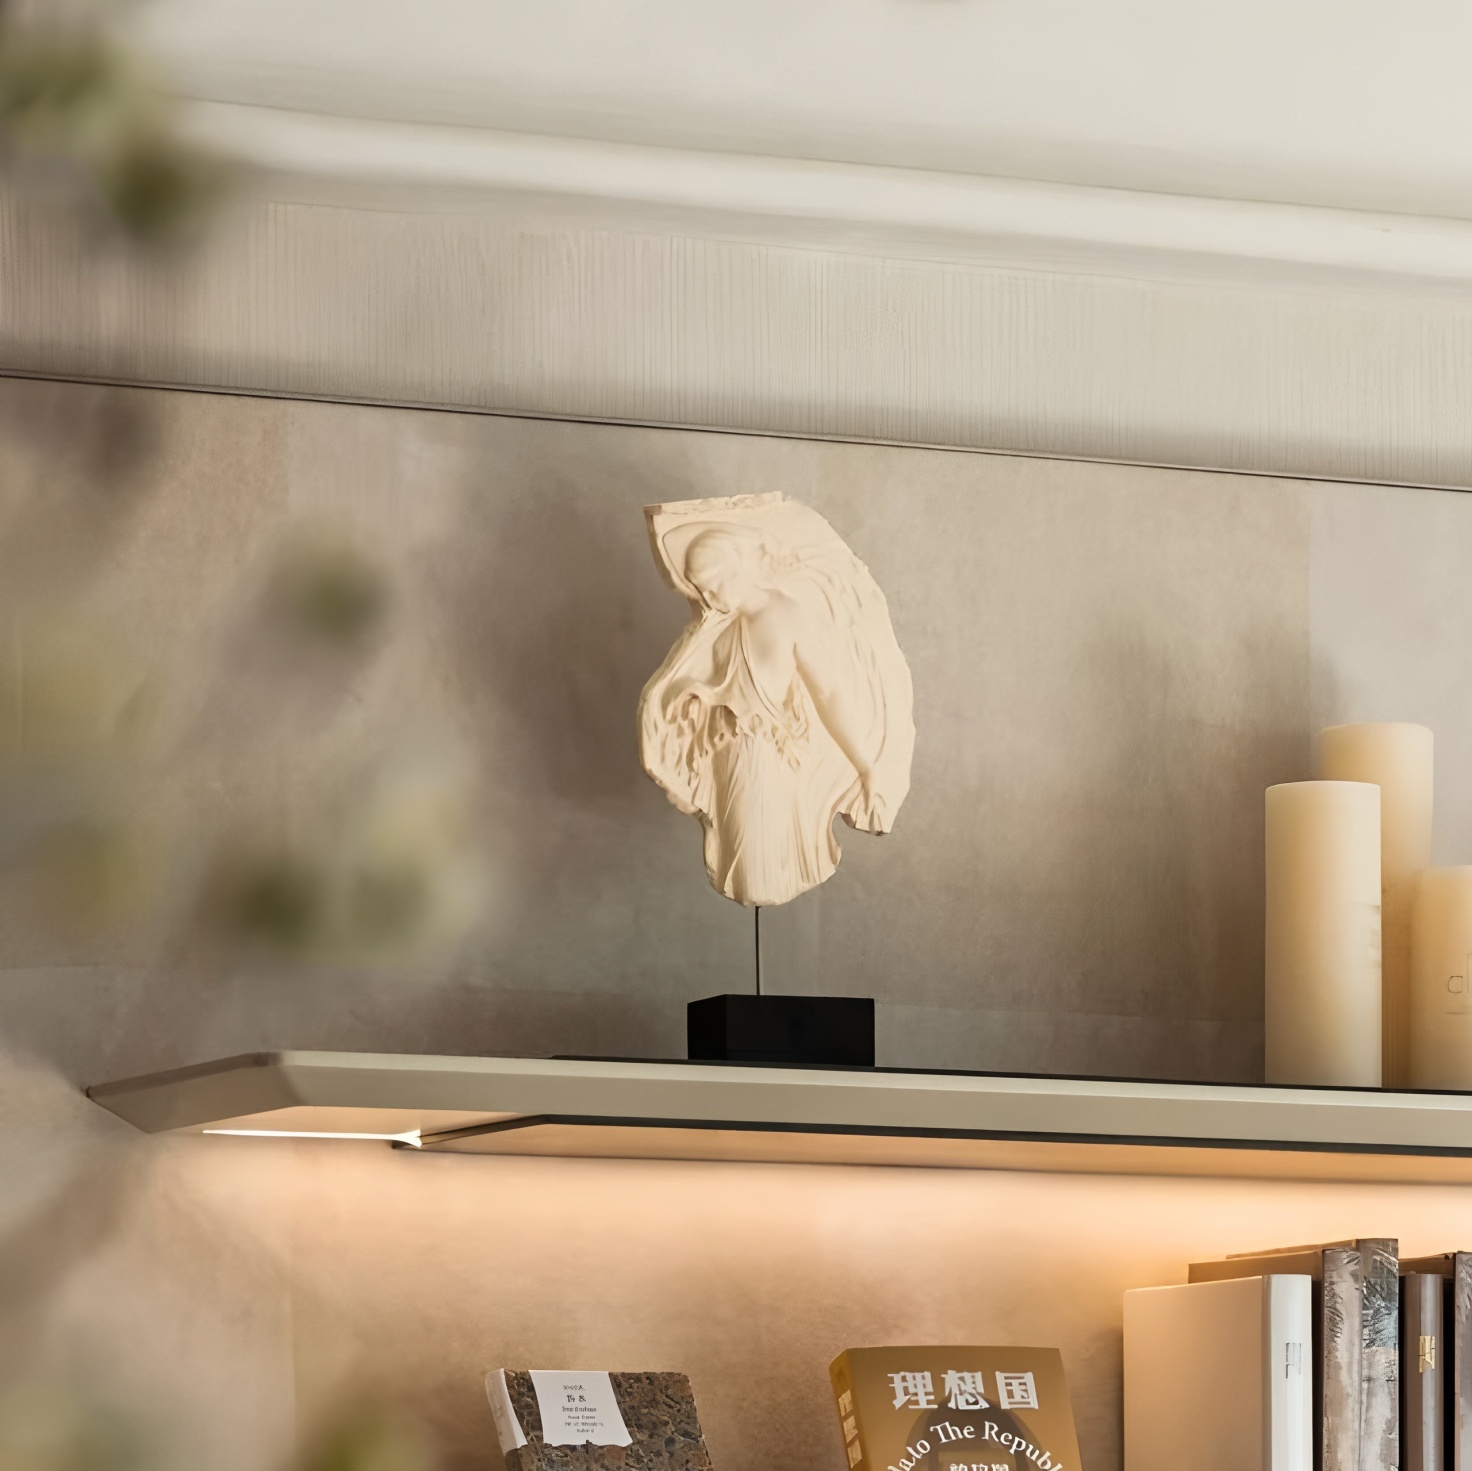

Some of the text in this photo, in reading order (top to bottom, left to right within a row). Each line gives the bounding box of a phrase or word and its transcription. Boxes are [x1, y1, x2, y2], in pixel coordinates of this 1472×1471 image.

[887, 1369, 1039, 1410] 理想国
[930, 1421, 976, 1444] The
